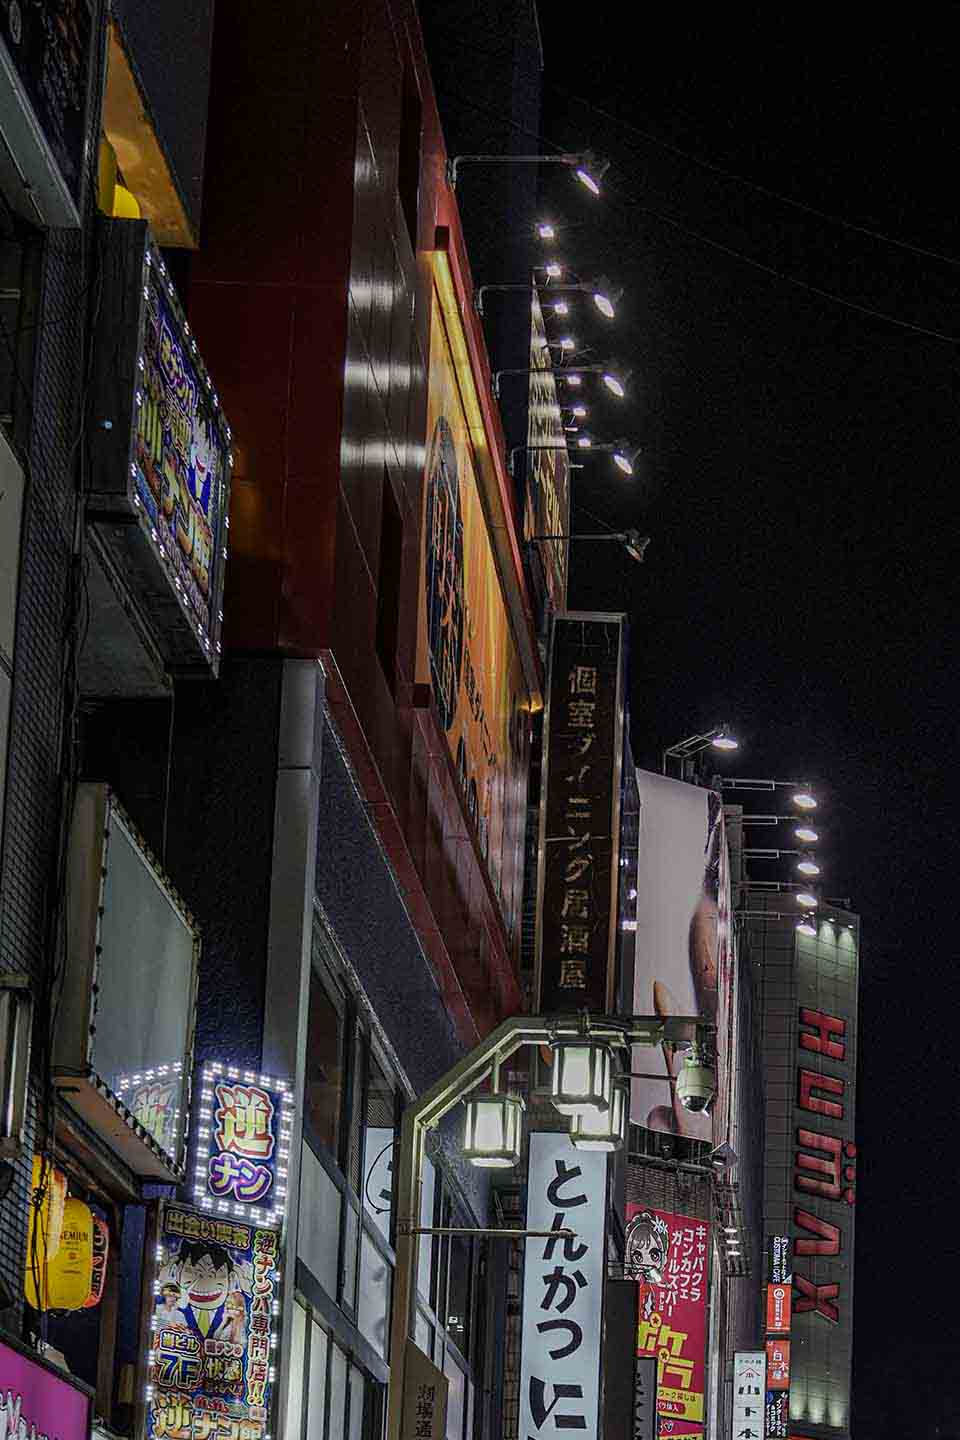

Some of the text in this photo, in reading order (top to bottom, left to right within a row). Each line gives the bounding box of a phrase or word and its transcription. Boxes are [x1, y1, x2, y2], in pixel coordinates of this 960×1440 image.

[680, 1228, 695, 1299] コンカフェ
[690, 1225, 707, 1302] キャバクラ
